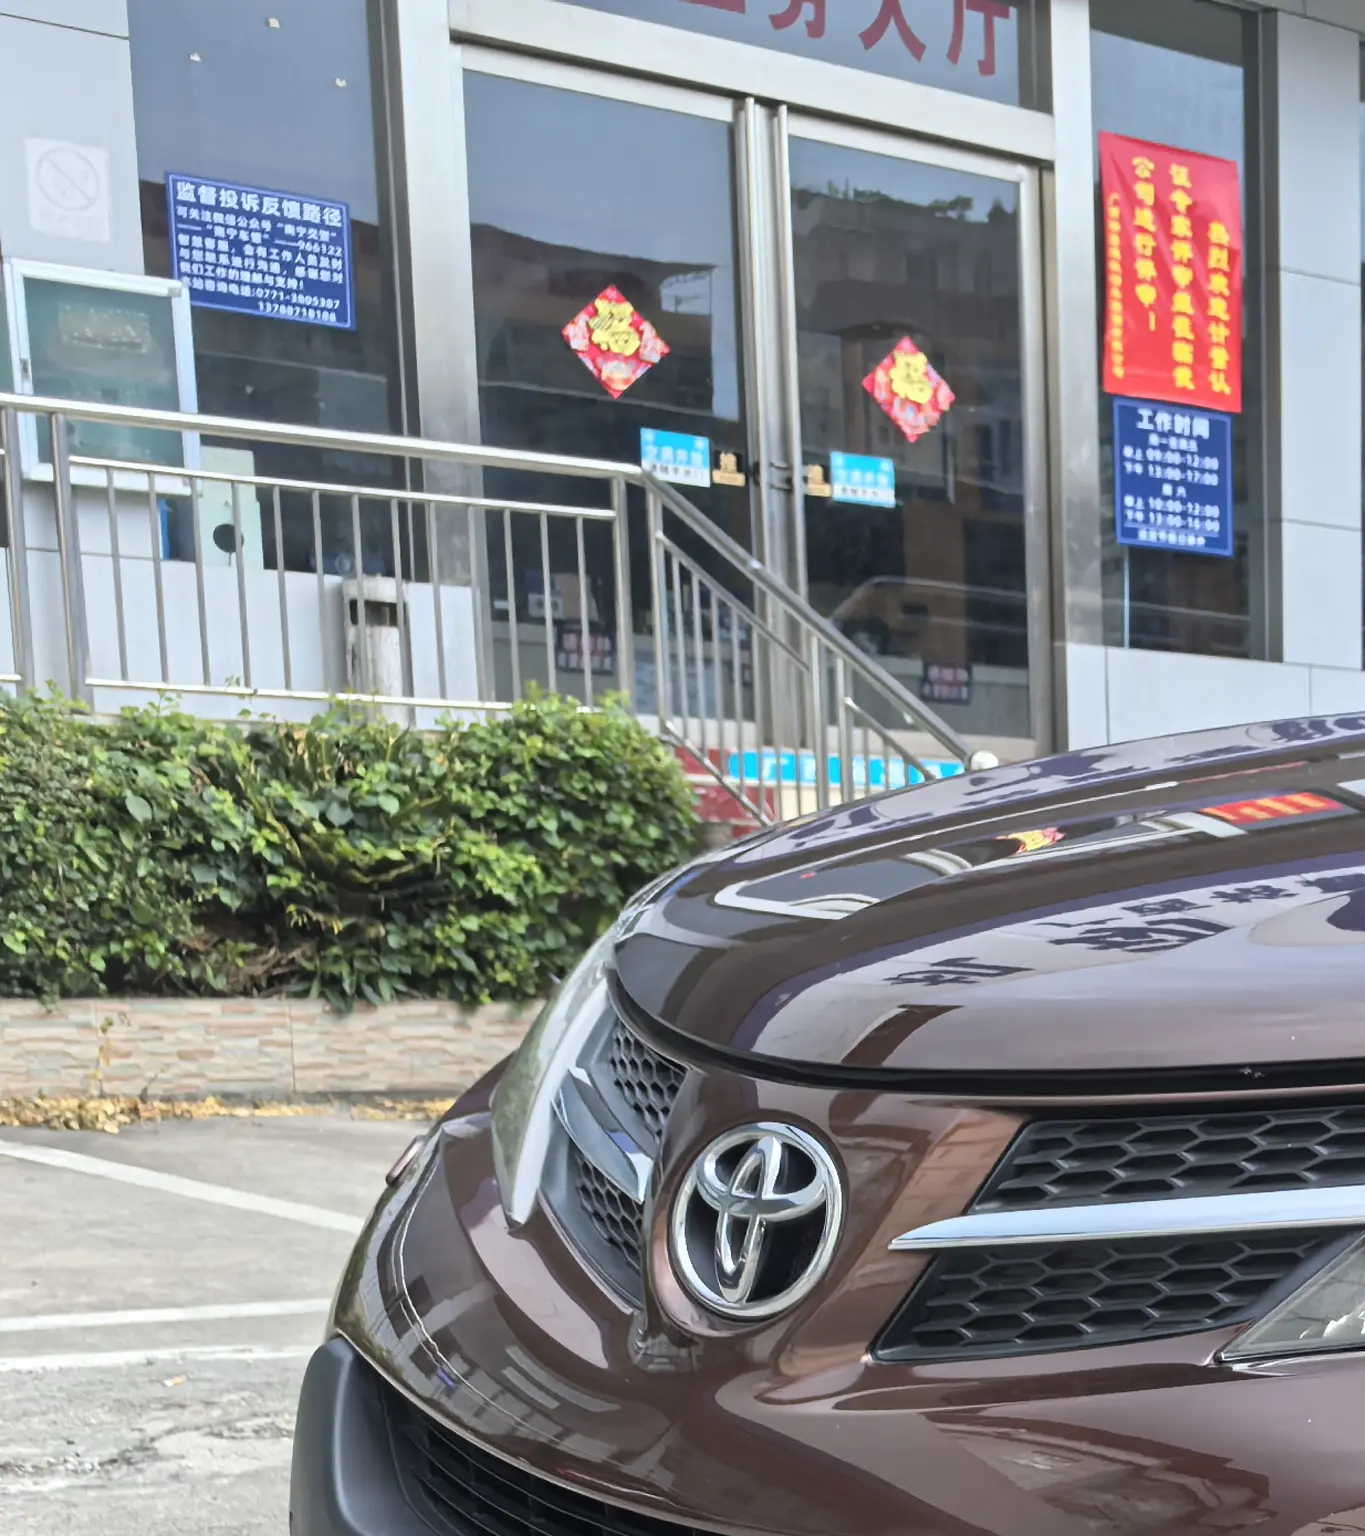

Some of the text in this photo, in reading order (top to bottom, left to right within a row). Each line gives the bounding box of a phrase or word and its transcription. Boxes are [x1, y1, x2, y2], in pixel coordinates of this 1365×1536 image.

[176, 181, 343, 228] 监督投诉反馈路径
[1136, 408, 1210, 440] 工作时间
